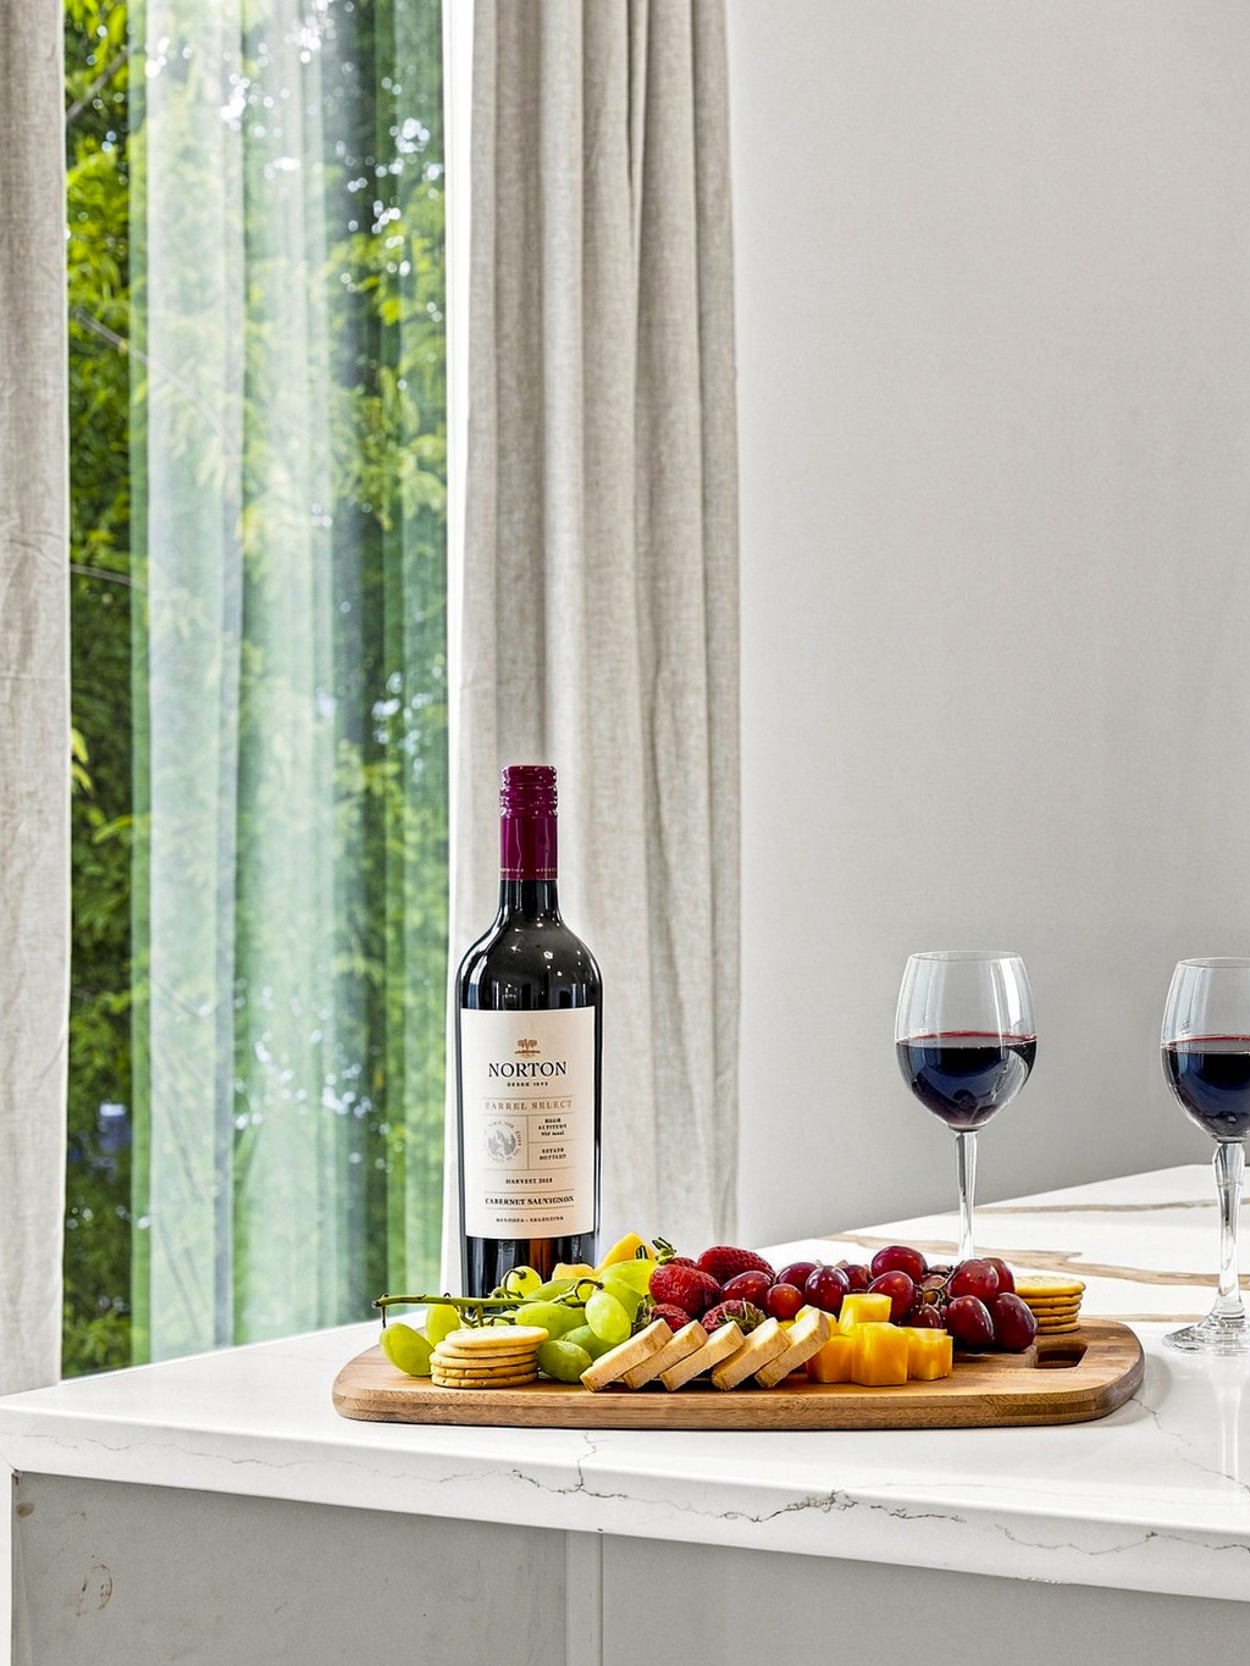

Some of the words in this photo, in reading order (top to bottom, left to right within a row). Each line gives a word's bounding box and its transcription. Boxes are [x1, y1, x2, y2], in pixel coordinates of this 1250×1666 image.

[489, 1061, 566, 1078] NORTON
[485, 1102, 528, 1110] BARREL
[531, 1100, 572, 1110] SELECT
[485, 1198, 526, 1206] CABERNET
[527, 1195, 574, 1205] SAUVIGNON
